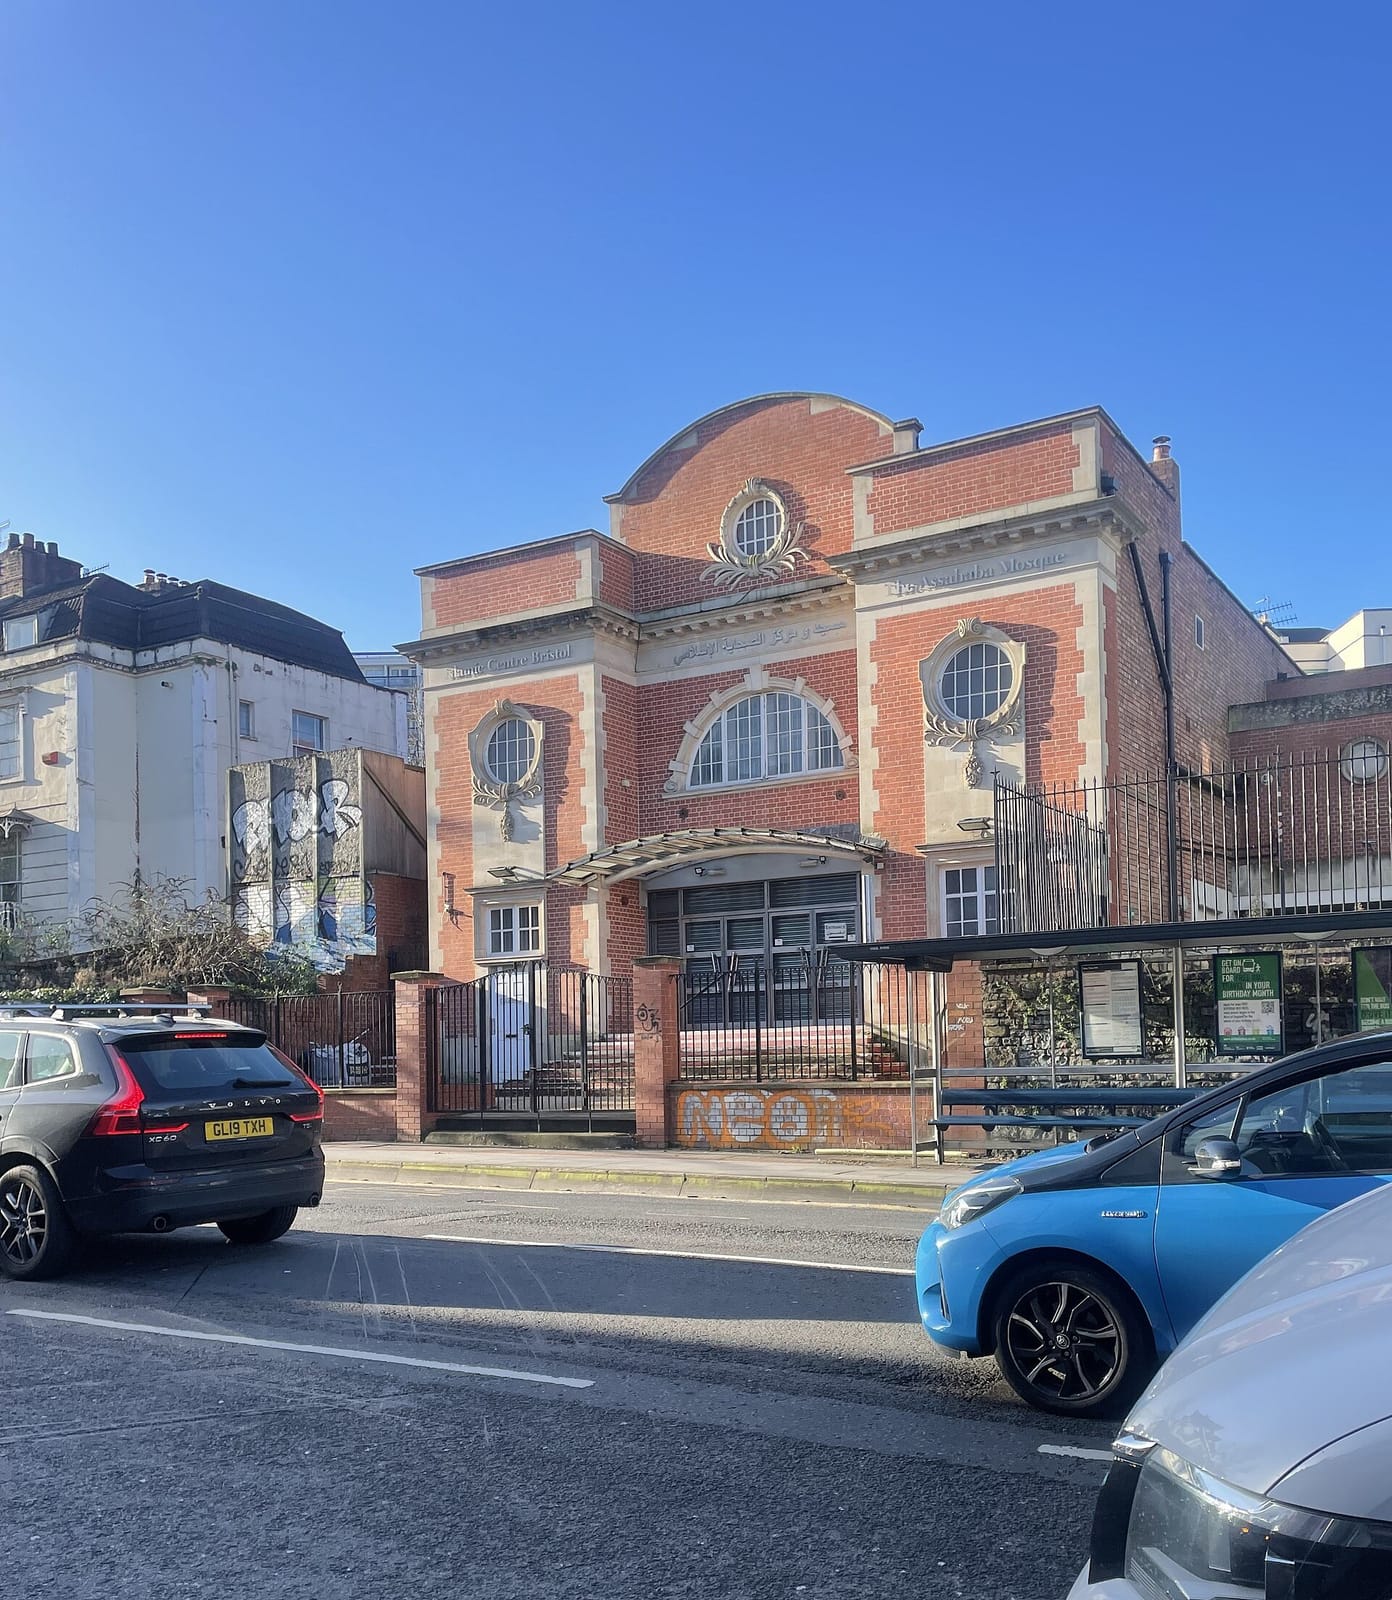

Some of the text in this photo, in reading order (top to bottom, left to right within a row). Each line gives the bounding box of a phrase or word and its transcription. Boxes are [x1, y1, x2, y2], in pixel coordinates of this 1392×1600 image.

[921, 563, 994, 588] Assahaba
[999, 552, 1065, 574] Mosque
[487, 656, 529, 673] Centre
[531, 643, 572, 666] Bristol
[1221, 959, 1242, 967] GET ON
[1221, 966, 1241, 974] BOARD
[1222, 974, 1235, 982] FOR
[1245, 981, 1252, 989] IN
[1253, 981, 1270, 989] YOUR
[1222, 989, 1274, 998] BIRTHDAY MONTH
[208, 1098, 281, 1109] VOLVO
[213, 1120, 266, 1137] GL19 TXH
